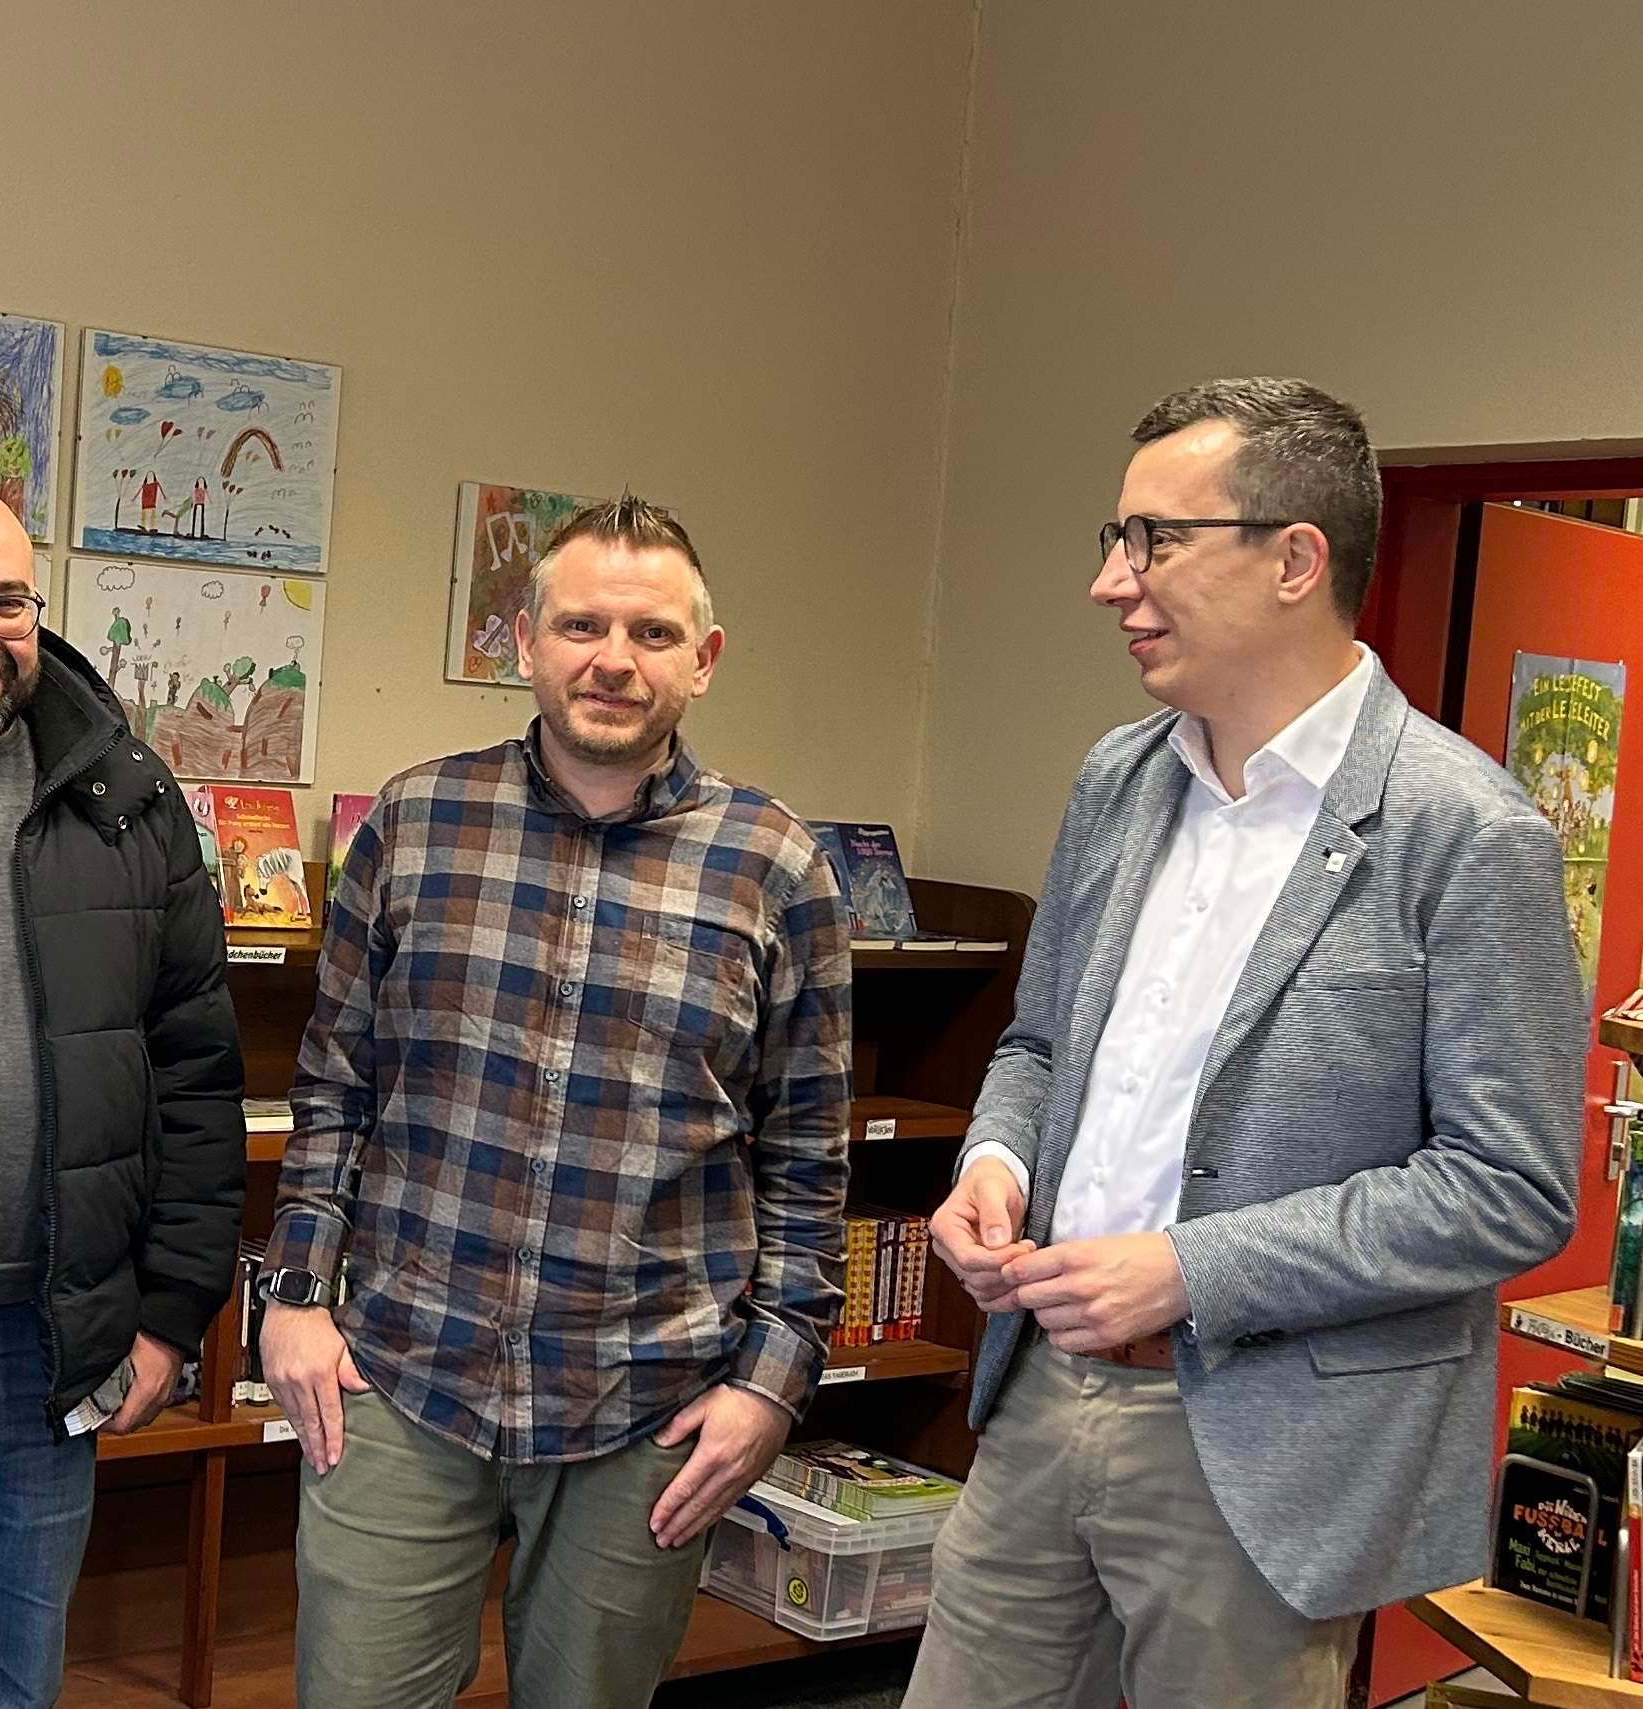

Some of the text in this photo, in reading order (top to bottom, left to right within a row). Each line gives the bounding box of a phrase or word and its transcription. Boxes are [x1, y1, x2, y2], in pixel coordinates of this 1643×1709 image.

[1533, 674, 1602, 702] EIN LESEFEST
[1552, 699, 1611, 742] LESELEITER
[1564, 1329, 1606, 1355] Bücher
[1512, 1503, 1607, 1547] FUSSBAL
